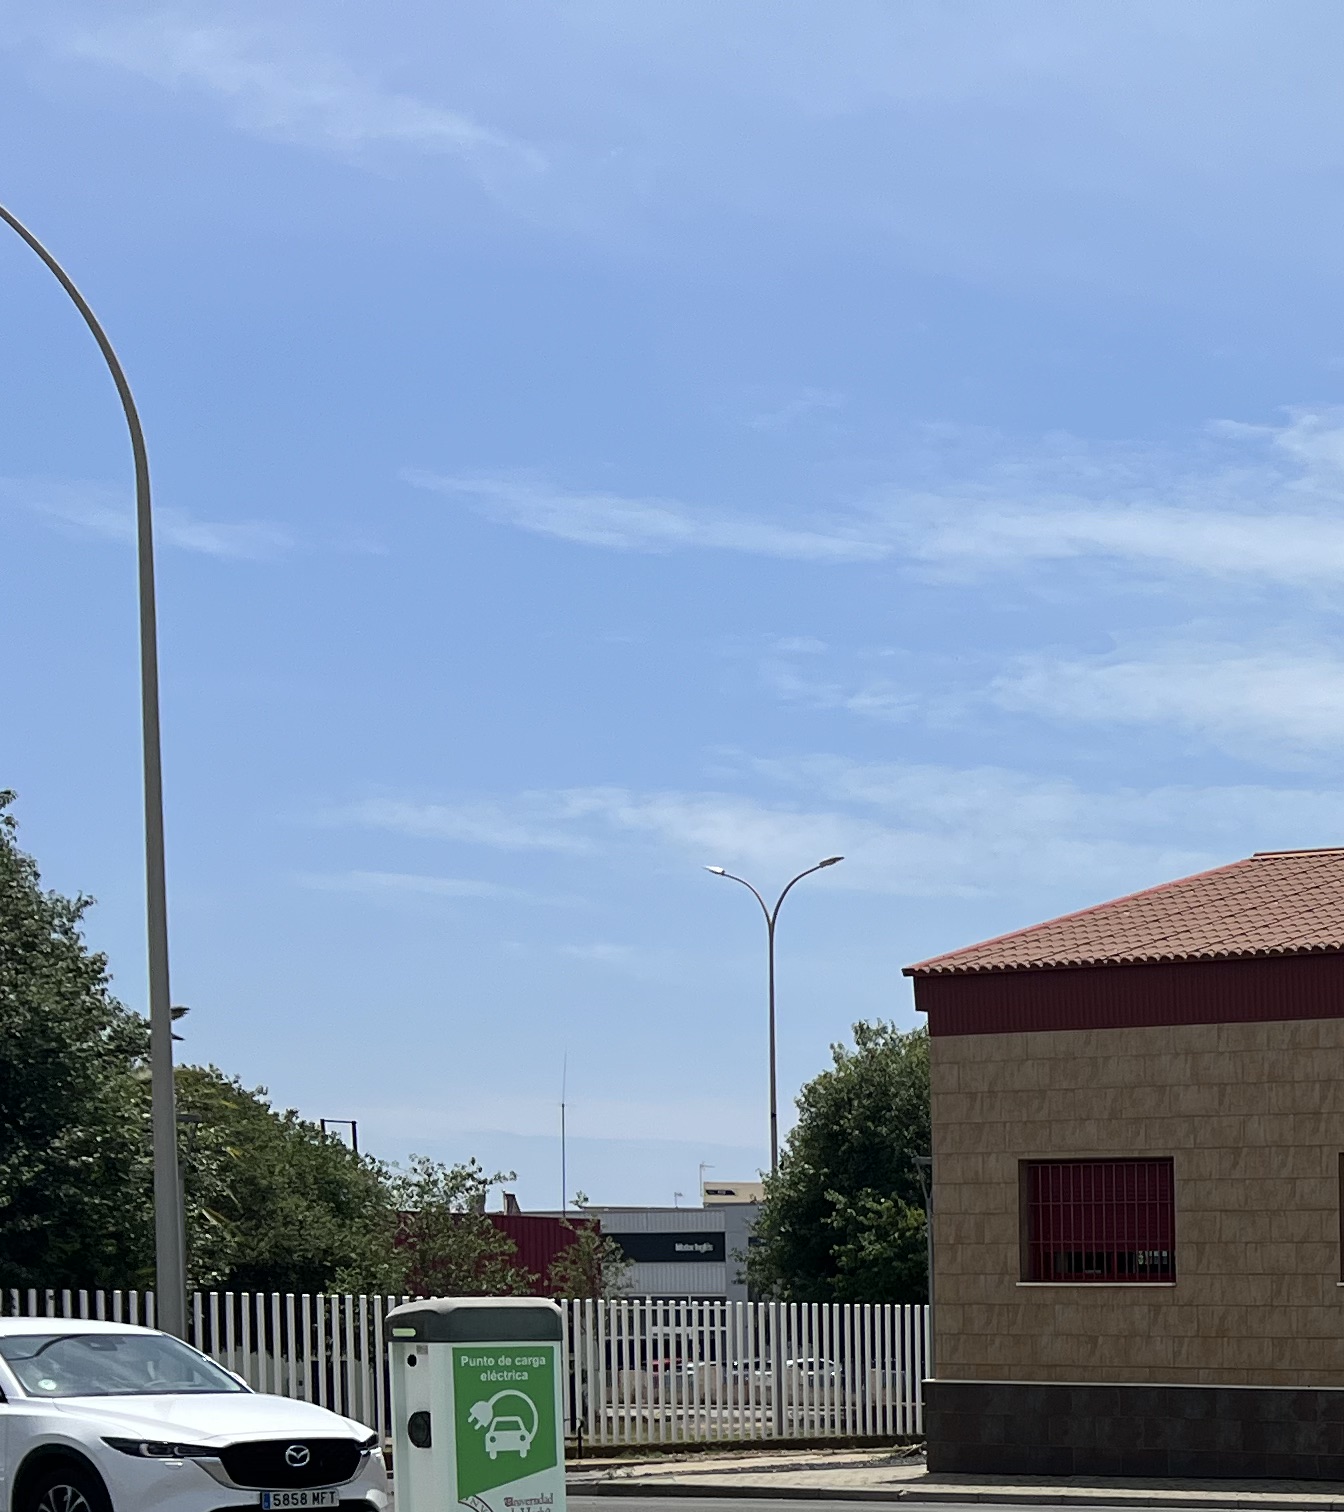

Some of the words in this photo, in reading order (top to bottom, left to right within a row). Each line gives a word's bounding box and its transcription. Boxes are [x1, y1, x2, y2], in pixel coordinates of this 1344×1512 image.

[460, 1355, 495, 1367] Punto
[497, 1355, 512, 1366] de
[514, 1356, 546, 1368] carga
[480, 1369, 529, 1382] eléctrica
[273, 1492, 308, 1507] 5858
[312, 1490, 336, 1505] MFT
[503, 1492, 554, 1508] Universidad
